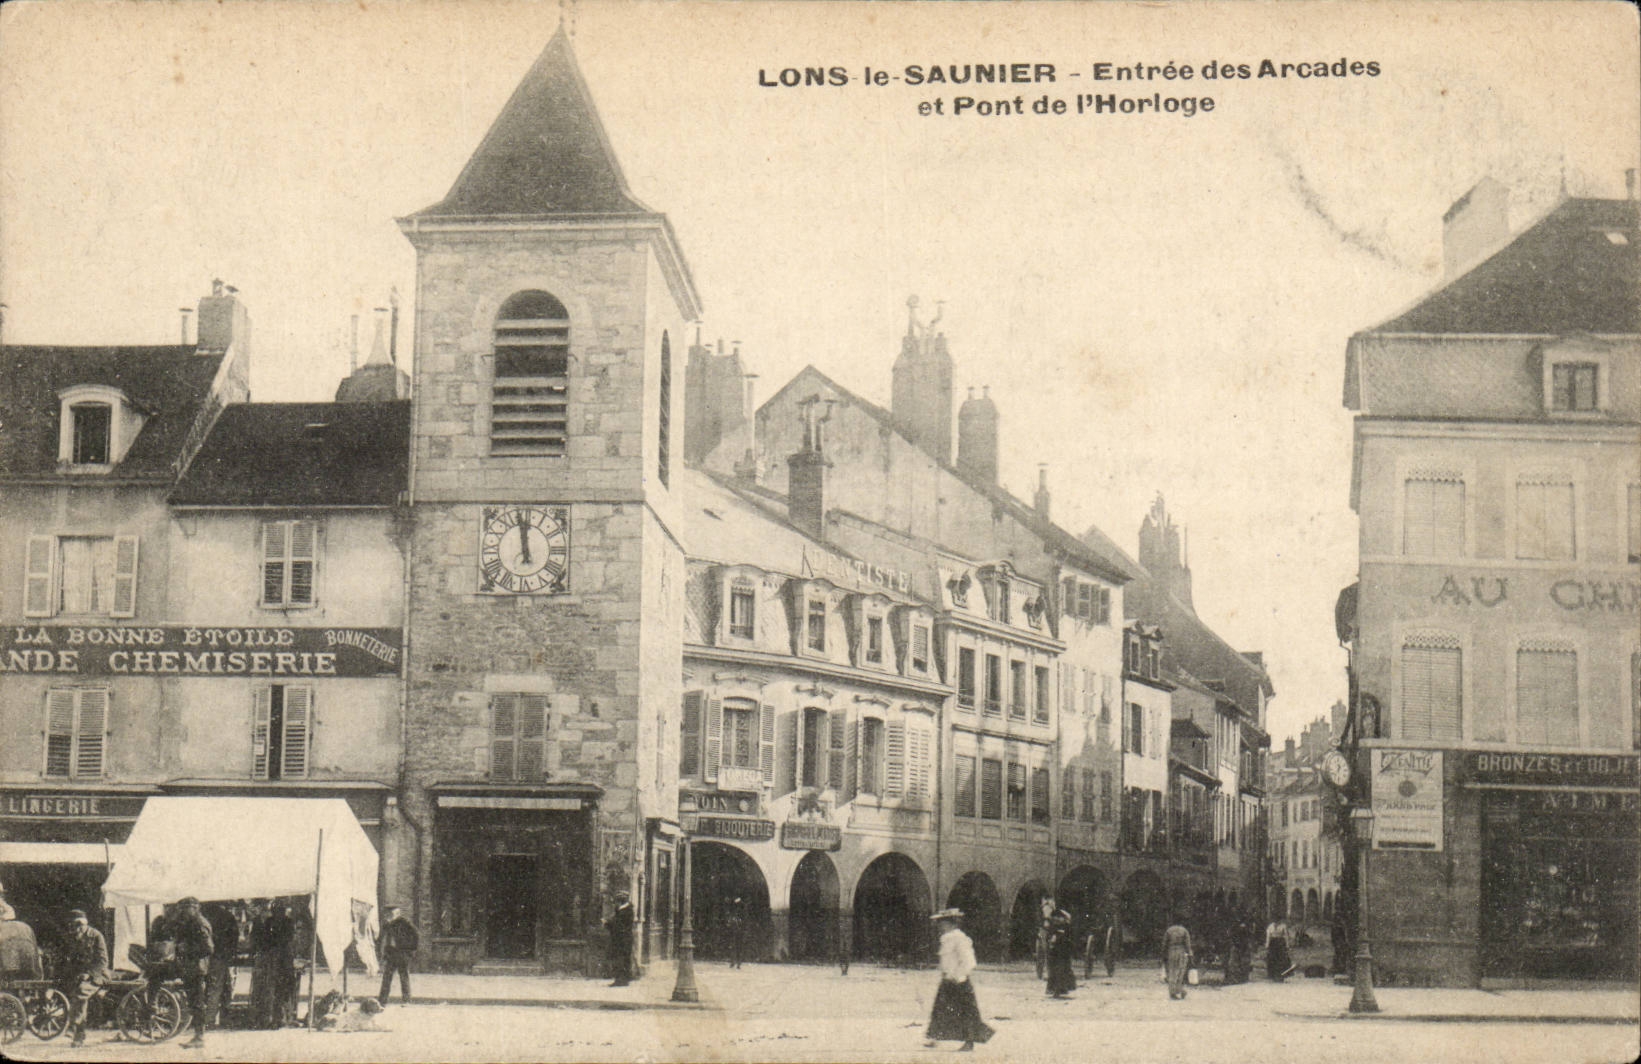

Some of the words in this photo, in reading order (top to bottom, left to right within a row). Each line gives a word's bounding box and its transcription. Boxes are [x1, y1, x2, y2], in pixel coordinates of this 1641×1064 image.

[1431, 574, 1509, 608] AU
[16, 627, 53, 645] LA
[67, 627, 165, 645] BONNE
[325, 629, 400, 666] BONNETERIE
[109, 651, 337, 674] CHEMISERIE
[1478, 754, 1561, 772] BRONZES
[8, 798, 100, 814] LINGERIE
